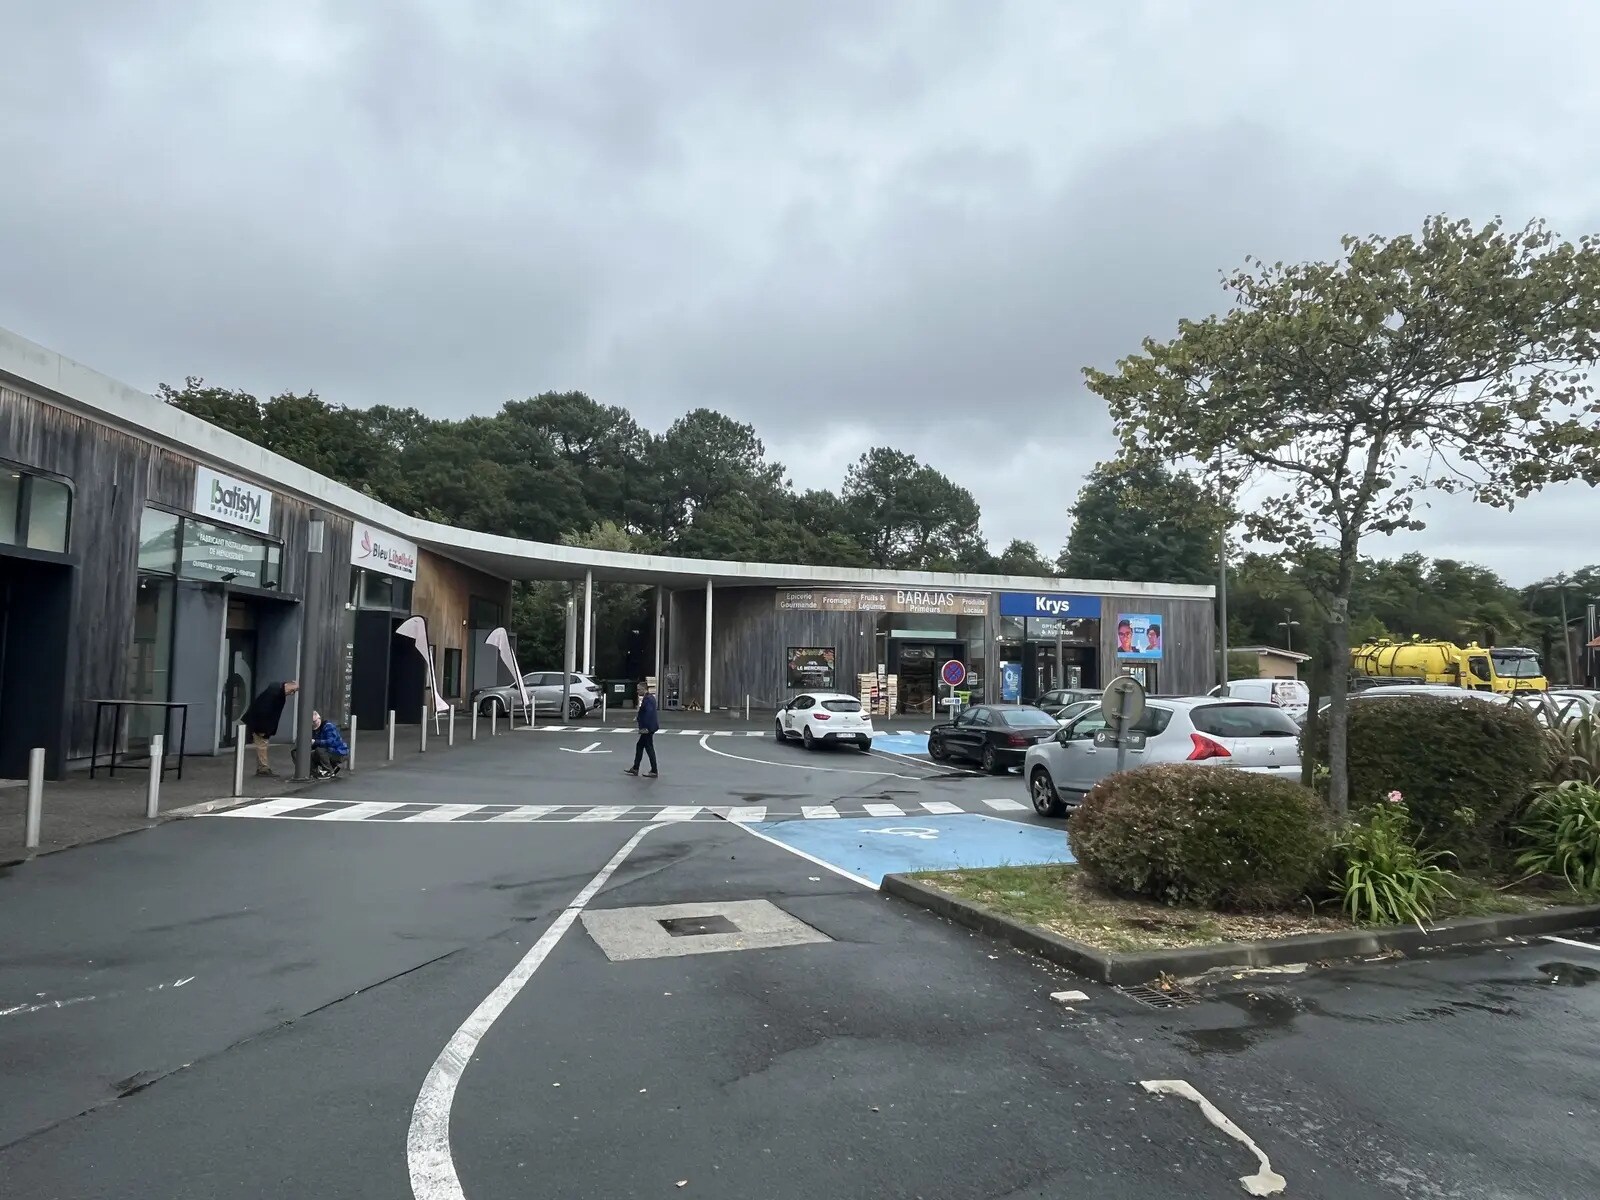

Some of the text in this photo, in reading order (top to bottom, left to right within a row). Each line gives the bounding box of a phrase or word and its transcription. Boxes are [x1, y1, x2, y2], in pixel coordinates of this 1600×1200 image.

[373, 543, 388, 560] Bleu
[822, 596, 852, 606] Fromage
[897, 590, 954, 606] BARAJAS
[962, 598, 985, 606] Produits
[780, 601, 818, 609] Gourmande
[910, 604, 941, 613] Primeurs
[1036, 596, 1070, 614] Krys
[963, 606, 984, 614] Locaux
